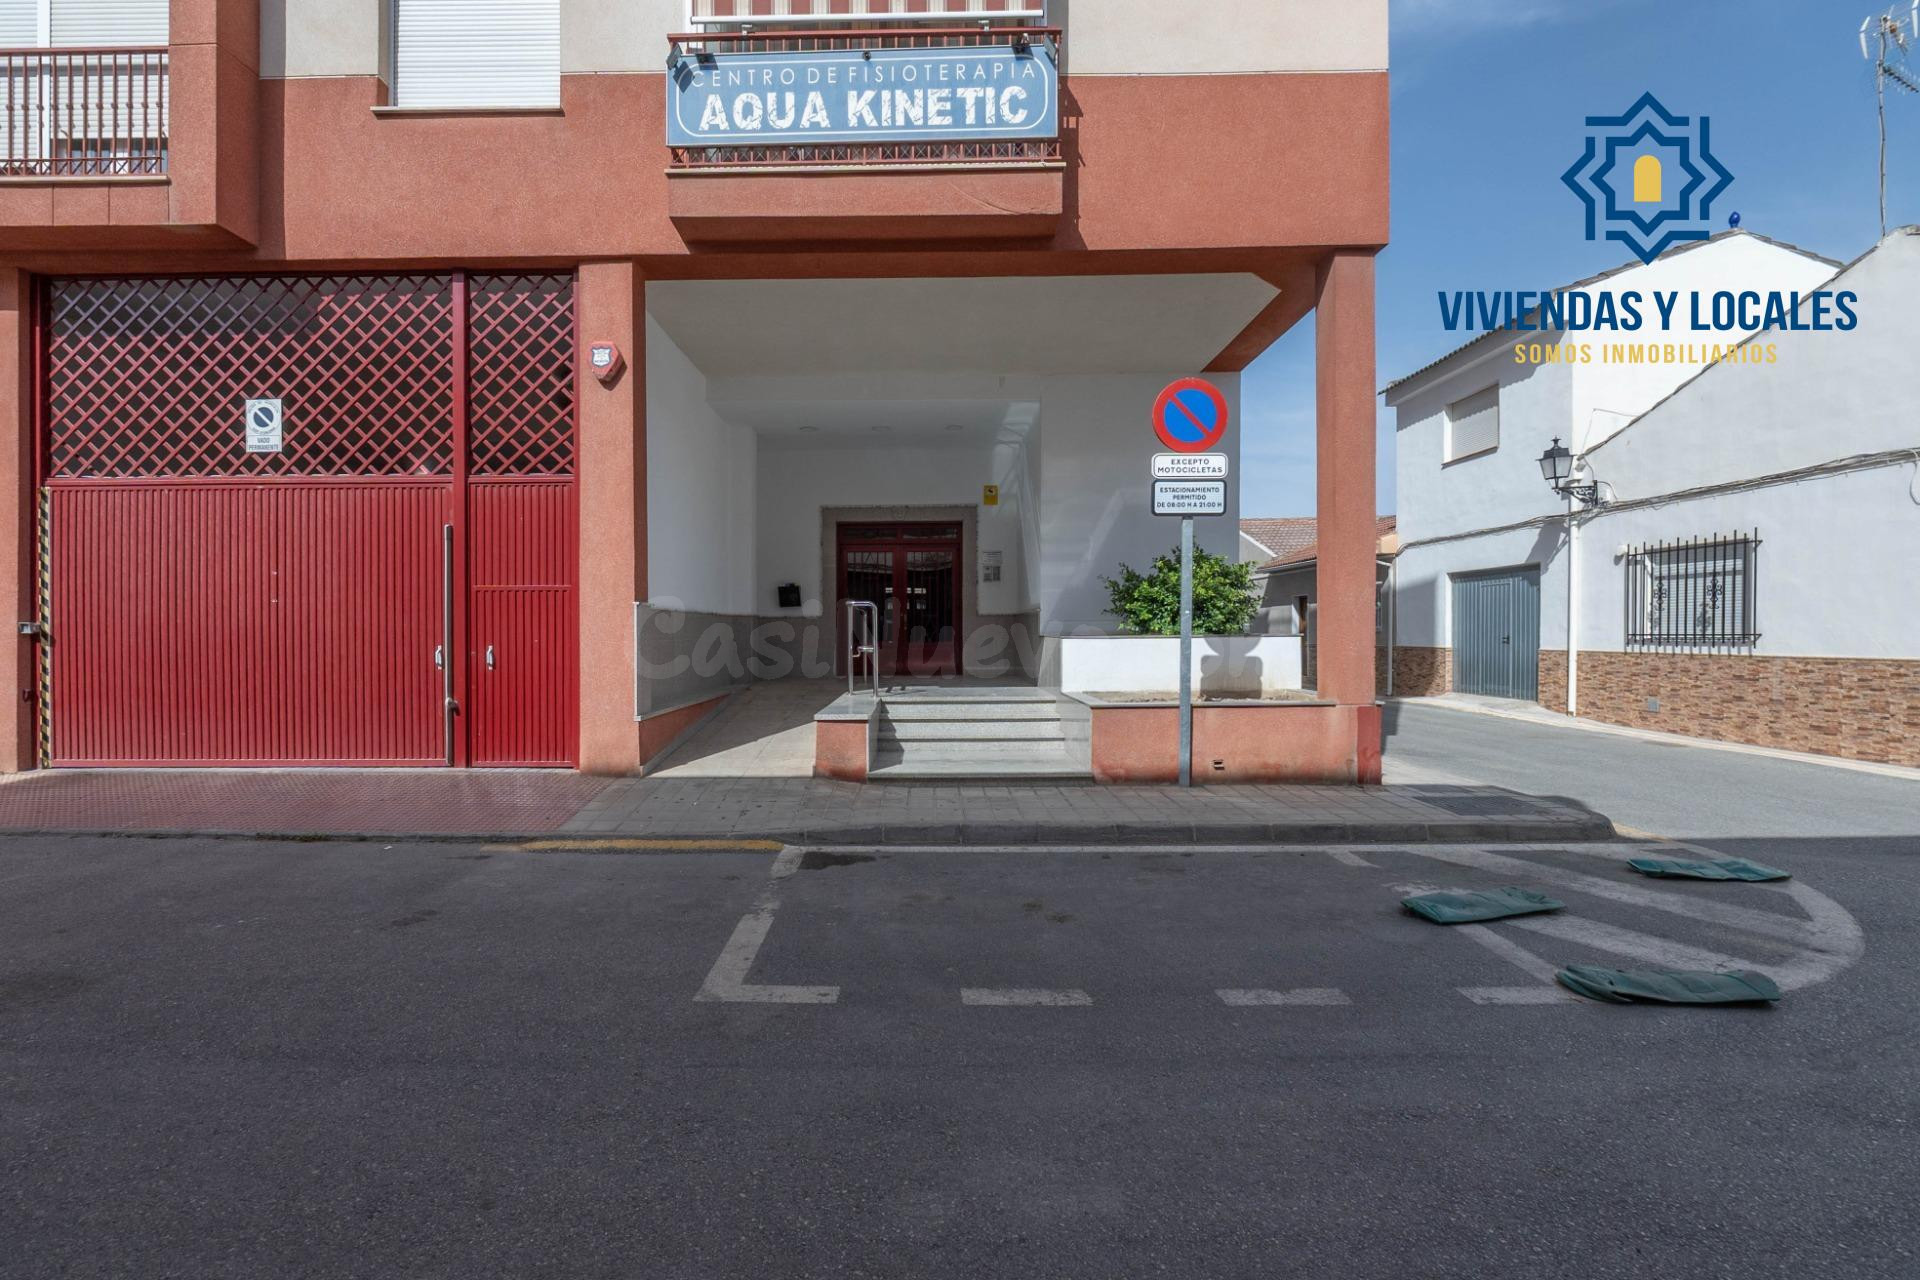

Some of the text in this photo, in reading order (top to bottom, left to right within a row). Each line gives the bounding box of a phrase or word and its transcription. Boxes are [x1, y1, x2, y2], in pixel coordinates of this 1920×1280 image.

[691, 62, 1035, 88] CENTRO DE FISIOTERAPIA
[698, 85, 1028, 130] AQUA KINETIC
